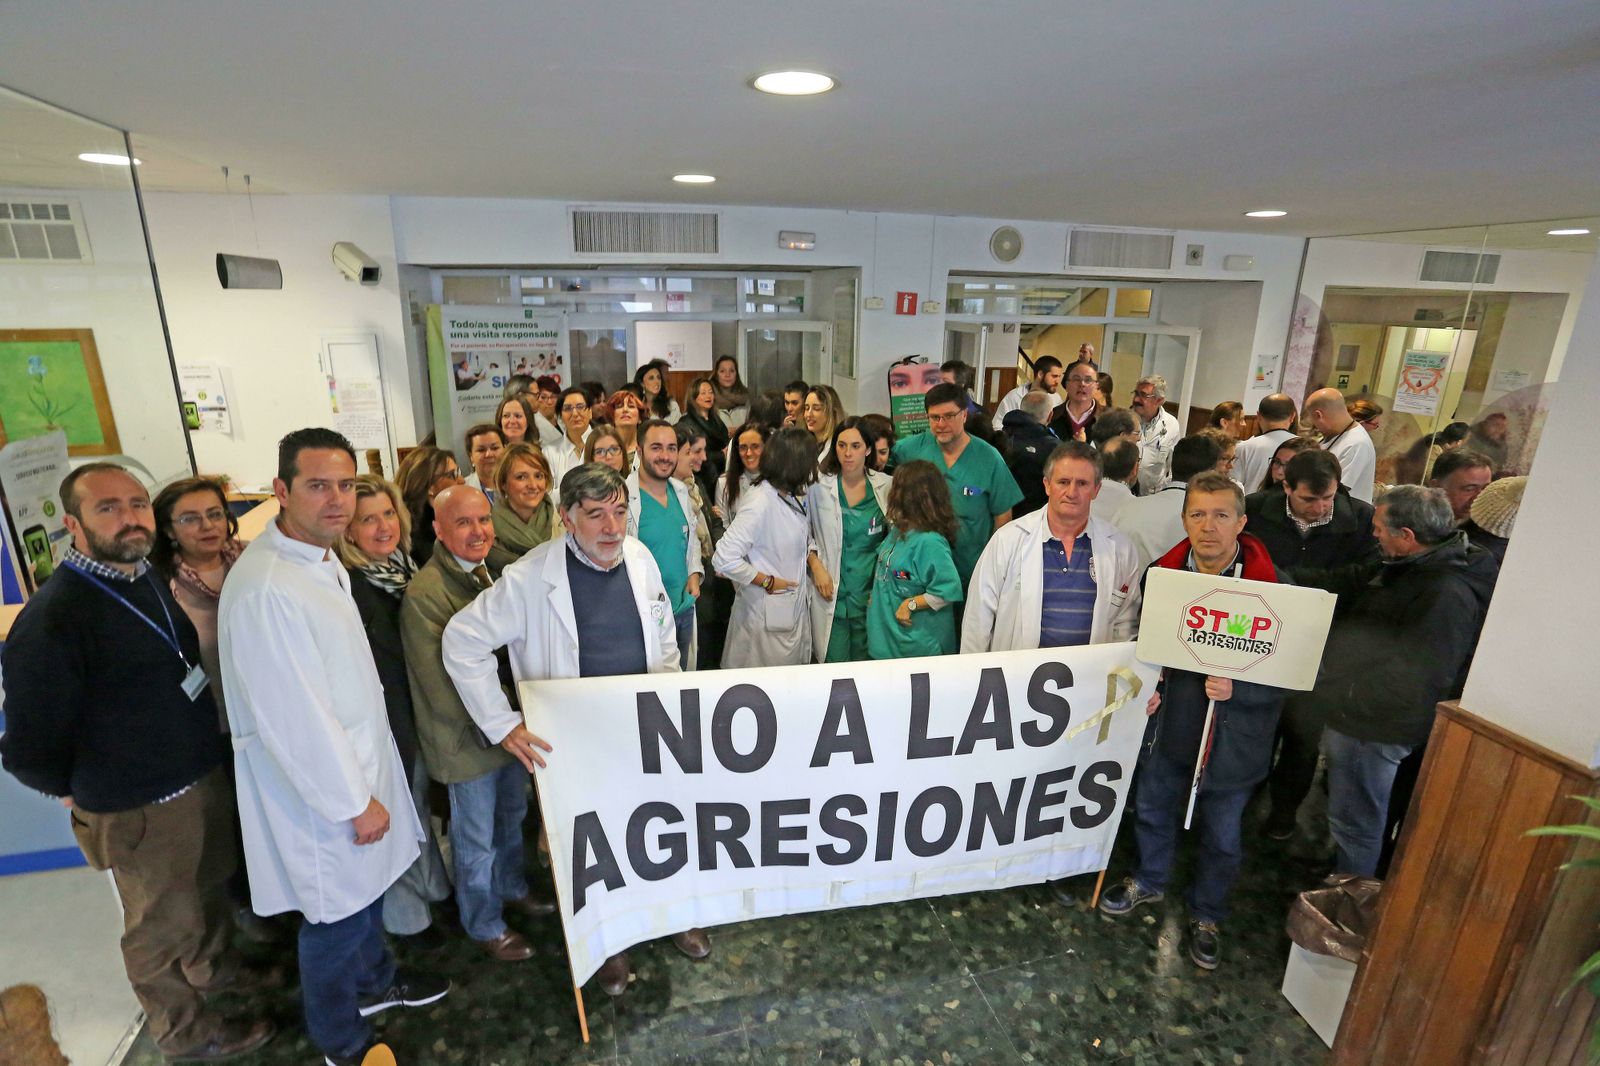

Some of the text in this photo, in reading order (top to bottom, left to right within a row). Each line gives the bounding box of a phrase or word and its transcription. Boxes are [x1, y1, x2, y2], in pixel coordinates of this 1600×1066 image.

[449, 320, 539, 330] Todo/as queremos
[472, 330, 500, 339] visita
[502, 330, 559, 340] responsable
[1186, 628, 1273, 656] AGRESIONES
[636, 661, 1075, 774] NO A LAS
[572, 760, 1123, 916] AGRESIONES
